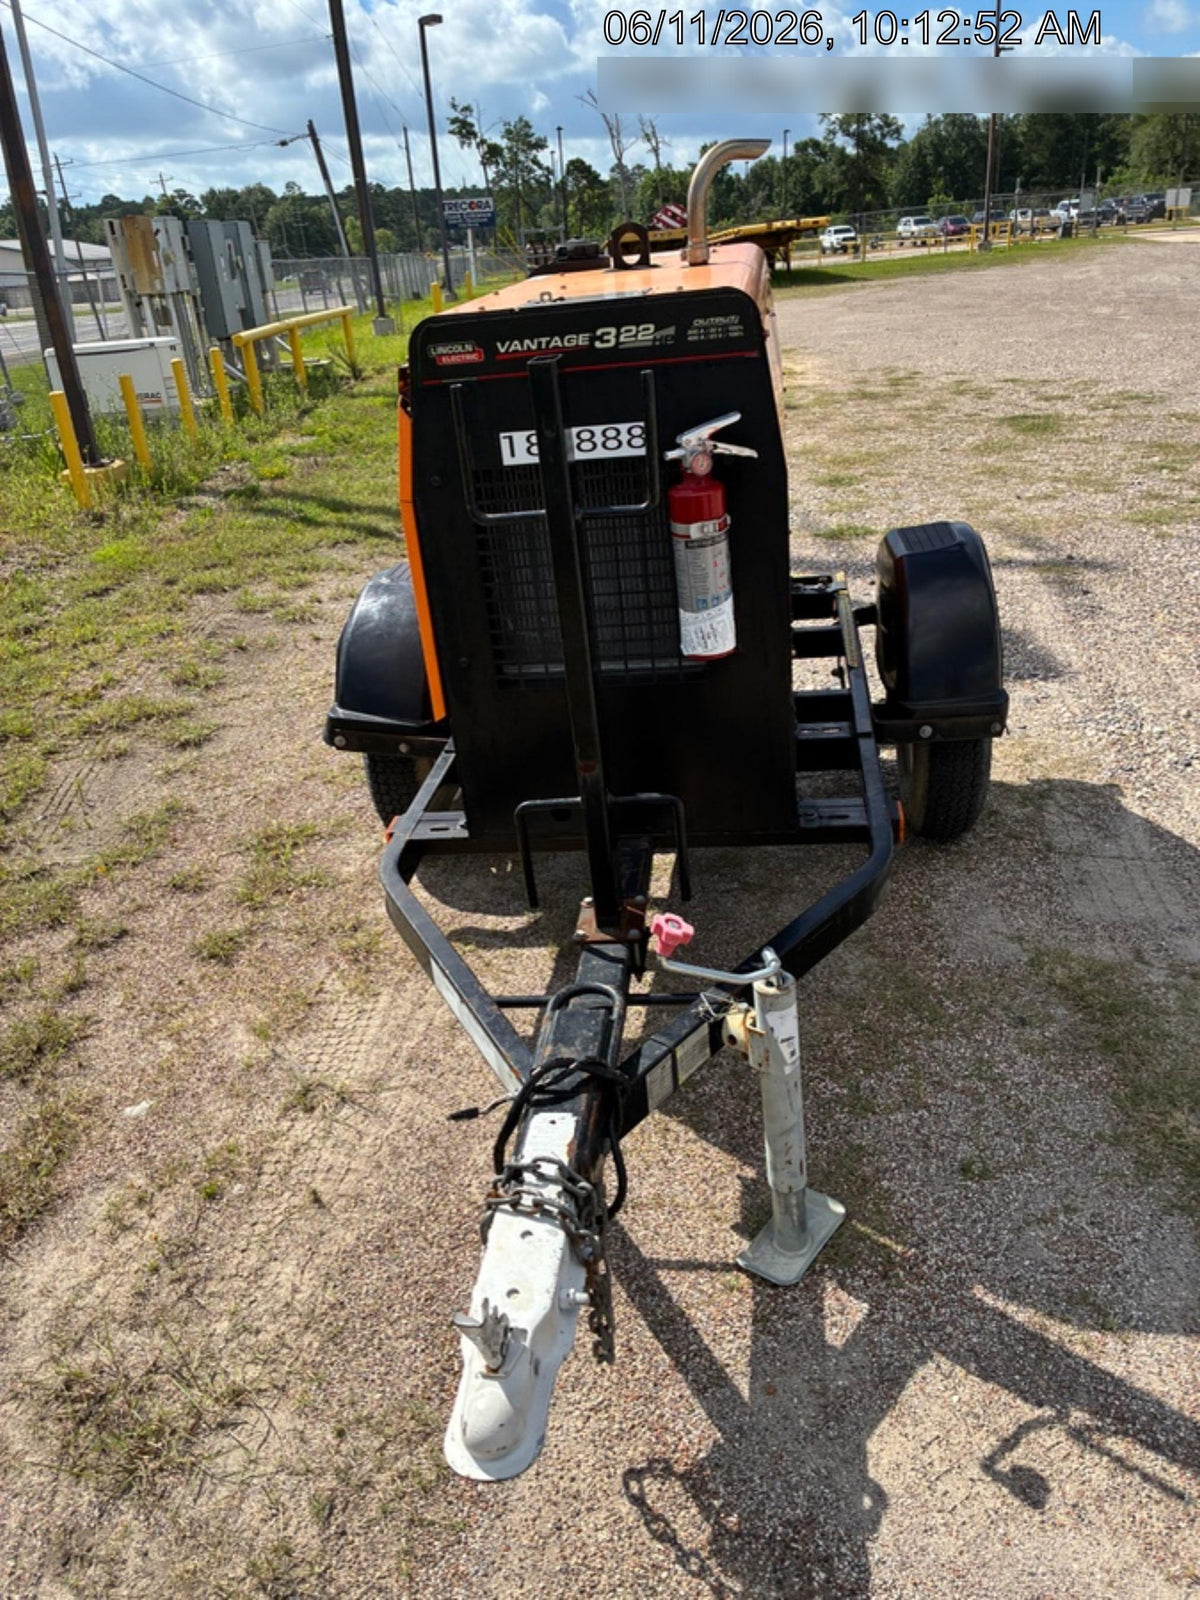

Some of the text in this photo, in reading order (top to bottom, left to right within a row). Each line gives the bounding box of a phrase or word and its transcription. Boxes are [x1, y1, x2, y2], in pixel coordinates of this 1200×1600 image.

[496, 333, 590, 353] VANTAGE
[594, 323, 656, 349] 322
[430, 343, 473, 355] LINCOLN
[442, 352, 479, 364] ELECTRIC
[502, 424, 646, 458] 18888
